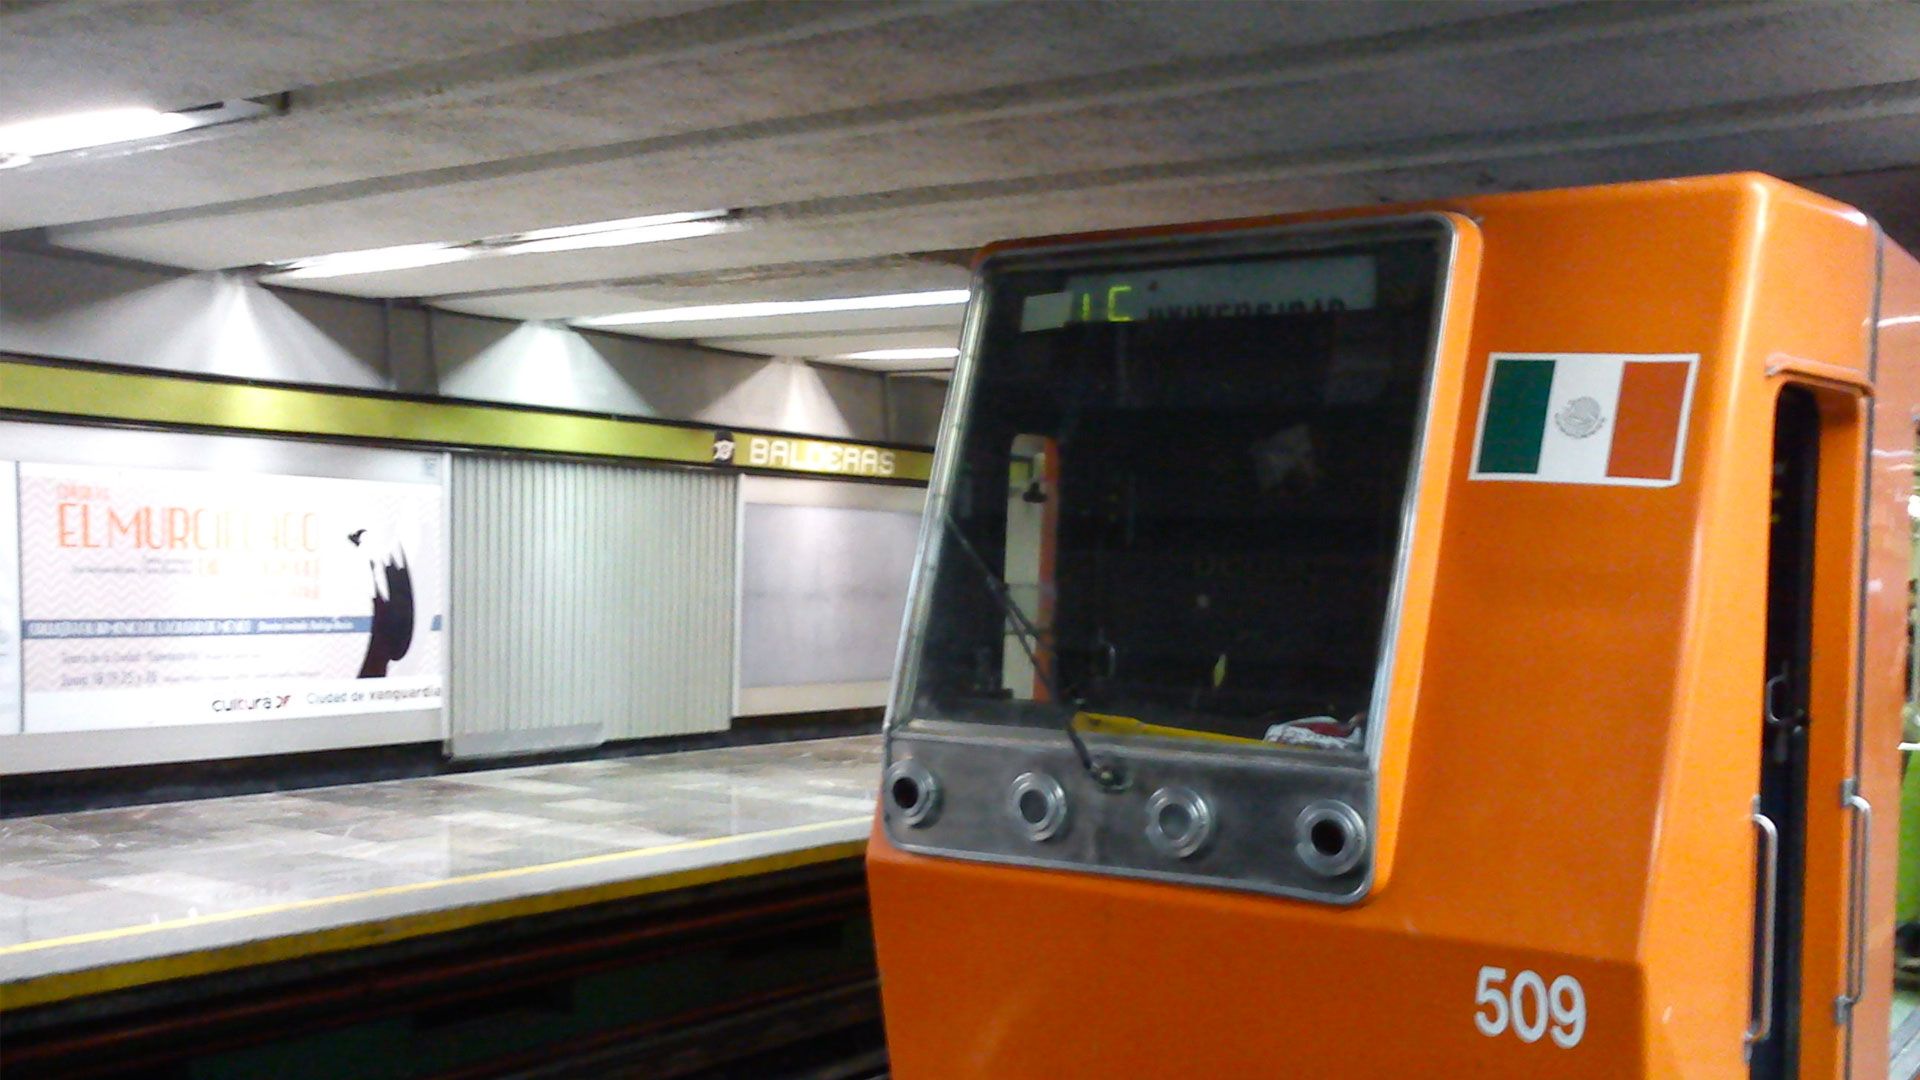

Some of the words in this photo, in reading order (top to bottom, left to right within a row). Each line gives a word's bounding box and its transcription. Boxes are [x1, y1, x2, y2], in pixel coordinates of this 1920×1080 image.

[749, 438, 895, 475] BALDERAS
[57, 502, 100, 549] EL
[212, 696, 271, 712] cultura
[306, 692, 347, 704] Ciudad
[350, 691, 364, 702] de
[1474, 965, 1587, 1049] 509
